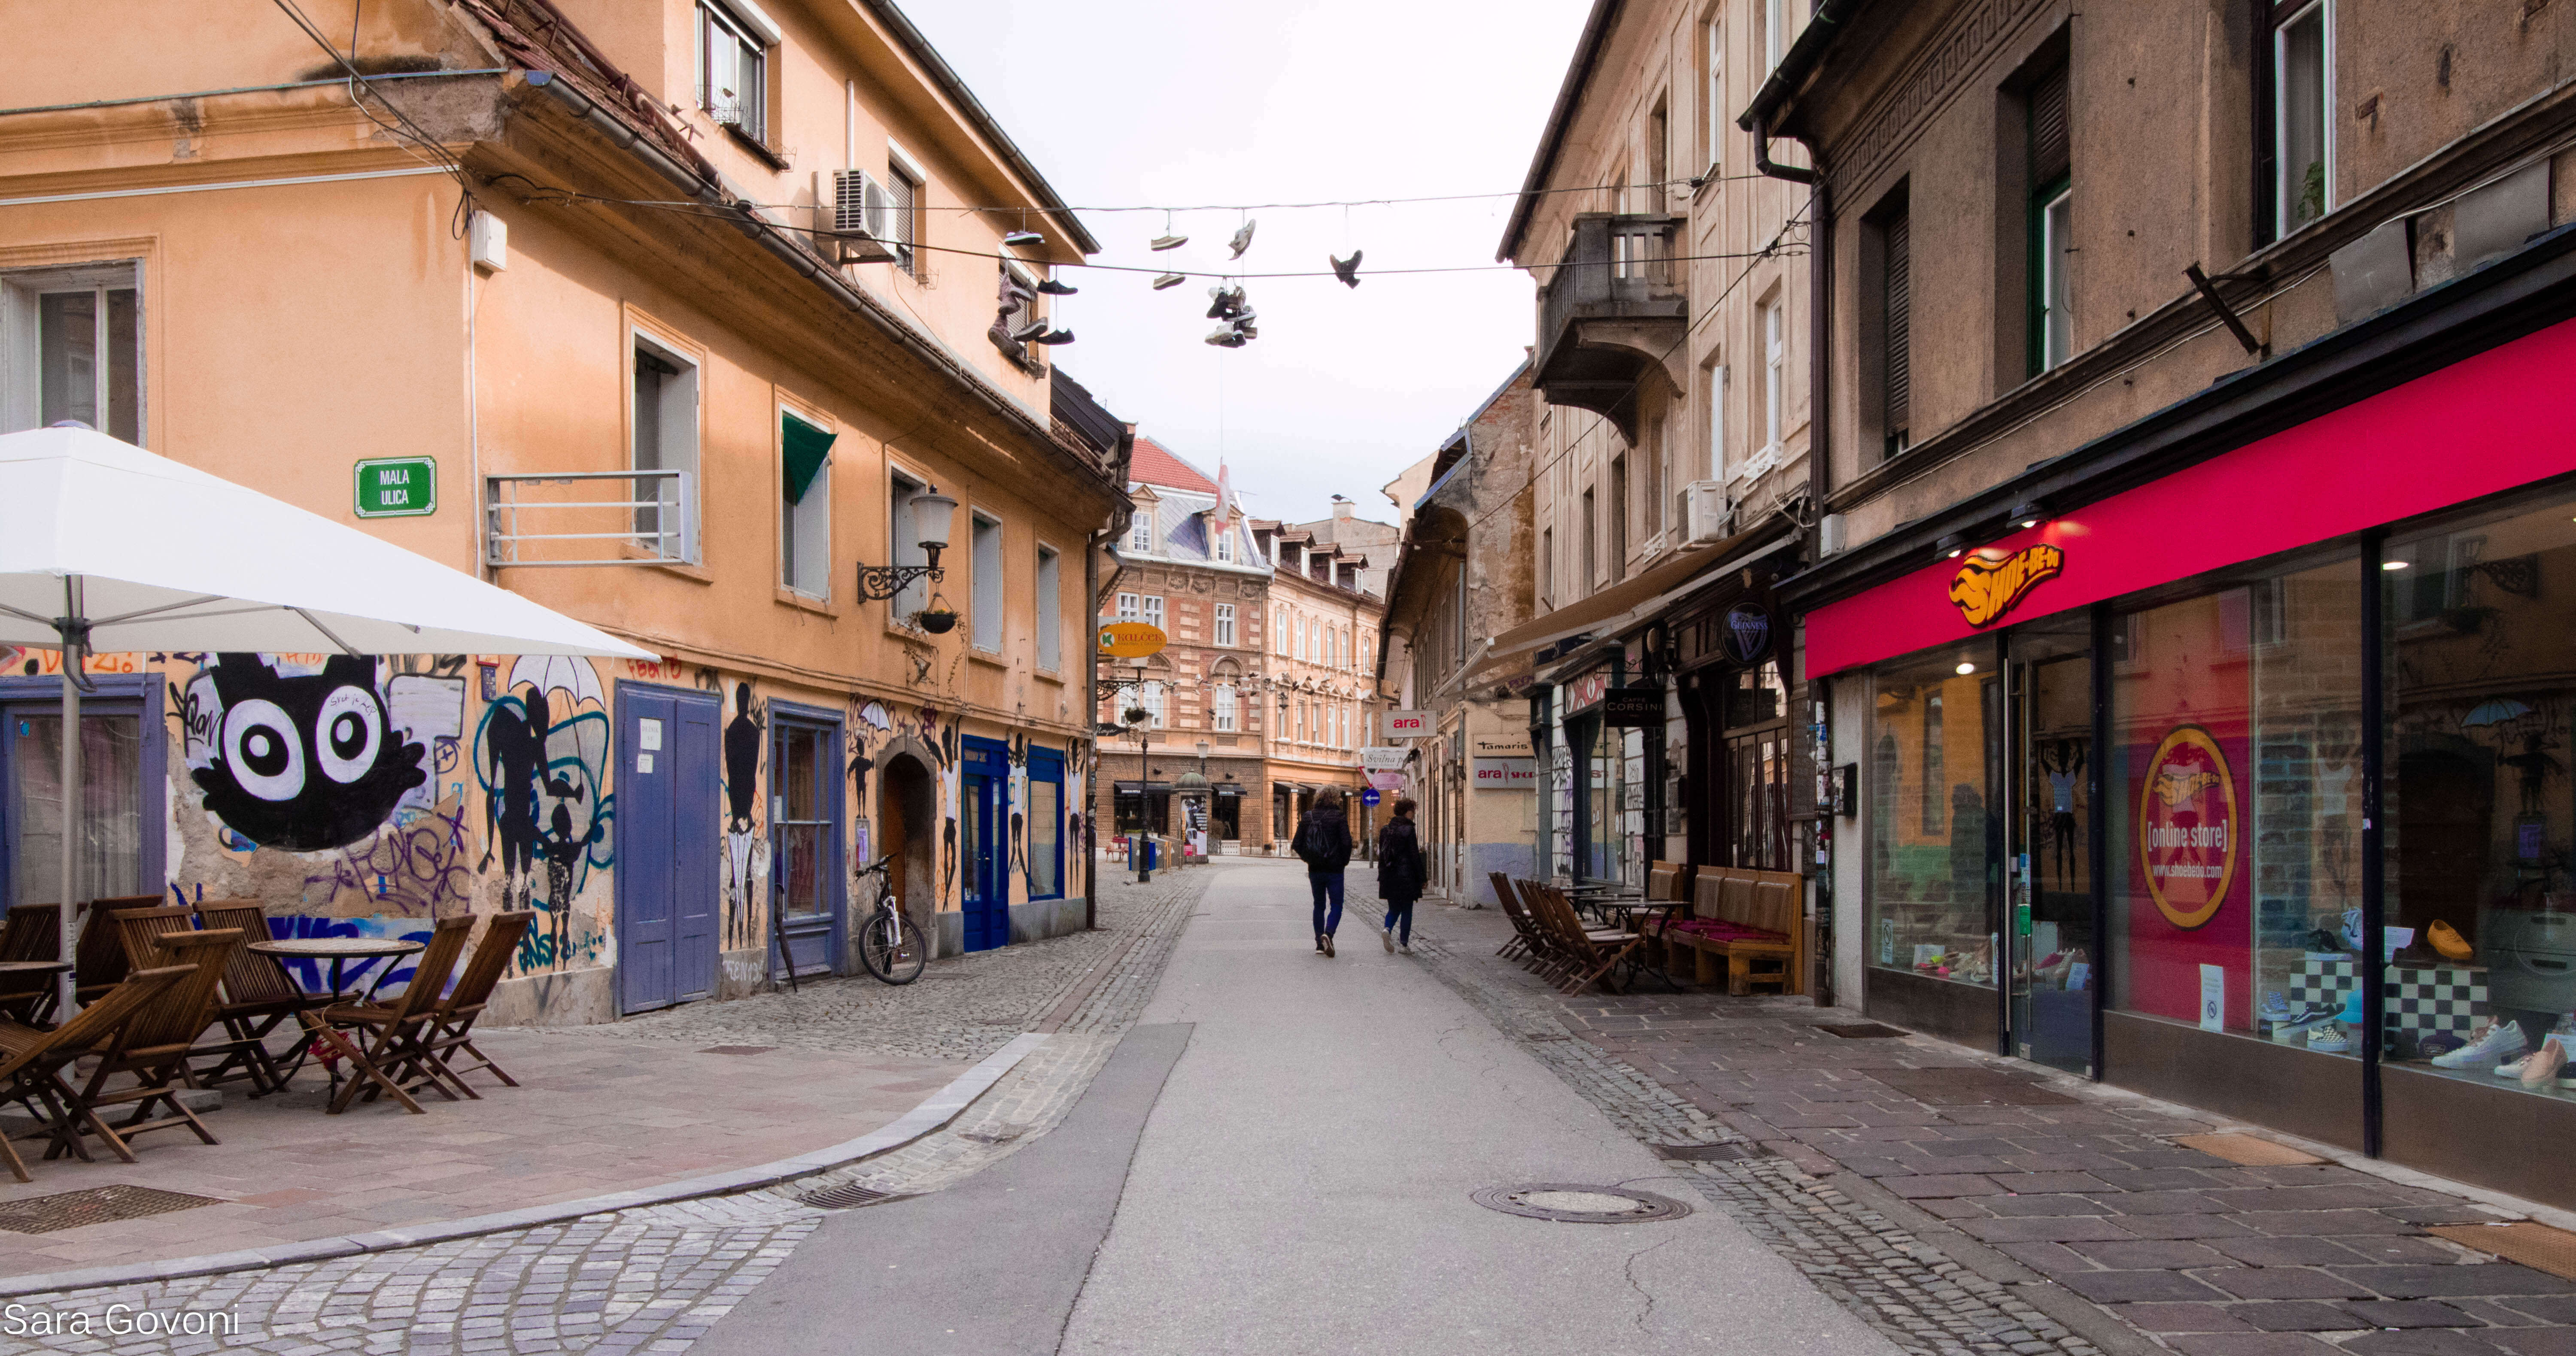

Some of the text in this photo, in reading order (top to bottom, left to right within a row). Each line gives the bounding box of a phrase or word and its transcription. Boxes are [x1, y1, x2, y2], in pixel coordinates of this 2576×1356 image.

[379, 469, 410, 485] MALA
[380, 489, 409, 505] ULICA
[1731, 621, 1768, 629] GUINNESS
[1607, 702, 1662, 711] CORSINI
[1394, 719, 1419, 728] ara
[1477, 741, 1528, 750] Tamaris
[1367, 754, 1395, 763] Svilna
[1478, 770, 1502, 779] ara
[2148, 819, 2227, 852] [online store]
[2153, 861, 2223, 878] www.shoebedo.com
